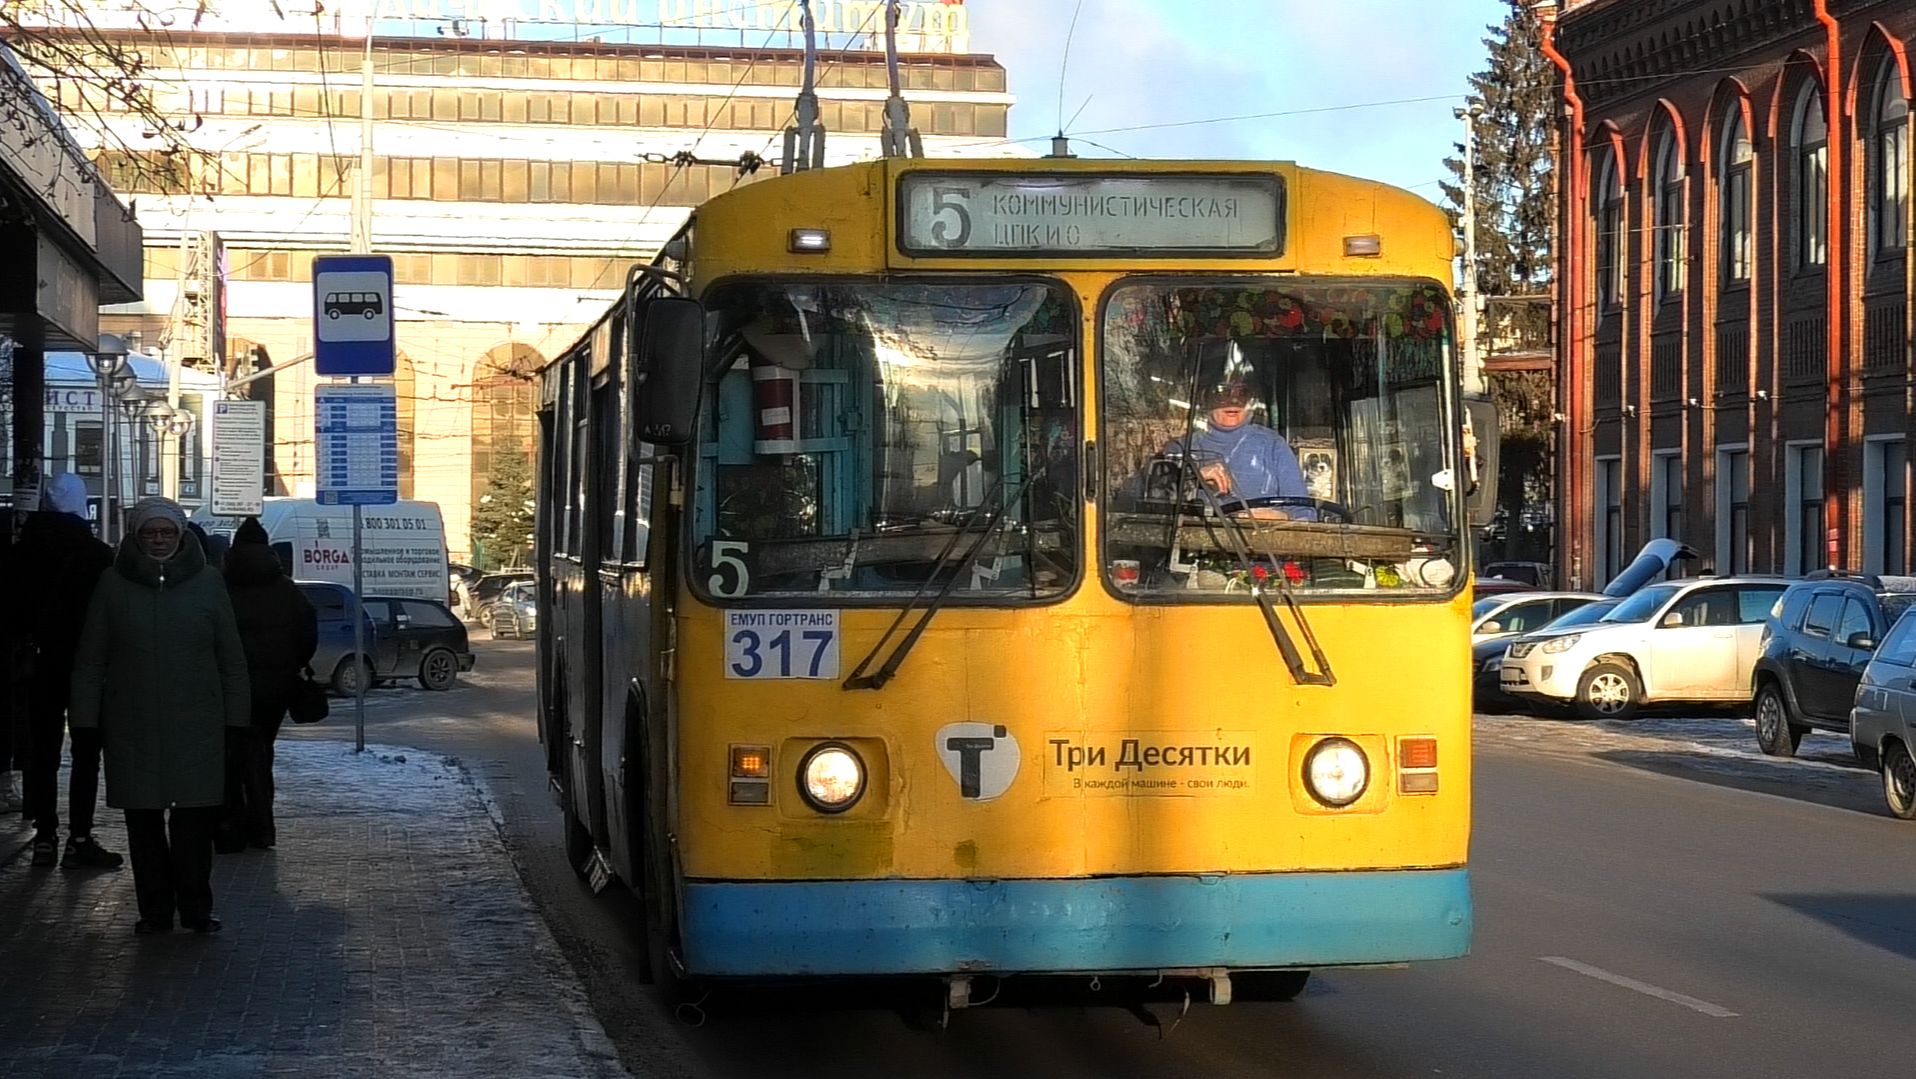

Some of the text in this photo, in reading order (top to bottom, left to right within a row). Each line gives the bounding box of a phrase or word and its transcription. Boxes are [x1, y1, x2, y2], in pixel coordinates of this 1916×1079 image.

[931, 187, 1238, 248] 5 КОММУНИСТИЧЕСКАЯ
[384, 518, 400, 529] 301
[402, 519, 414, 530] 05
[415, 519, 427, 530] 01
[708, 540, 749, 597] 5
[731, 613, 833, 626] ЕМУП ГОРТРАНС
[731, 630, 834, 677] 317
[1048, 739, 1250, 771] Три Десятки
[1073, 778, 1081, 788] В
[1084, 777, 1128, 790] каждой
[1131, 779, 1177, 789] машине
[1187, 779, 1214, 789] свои
